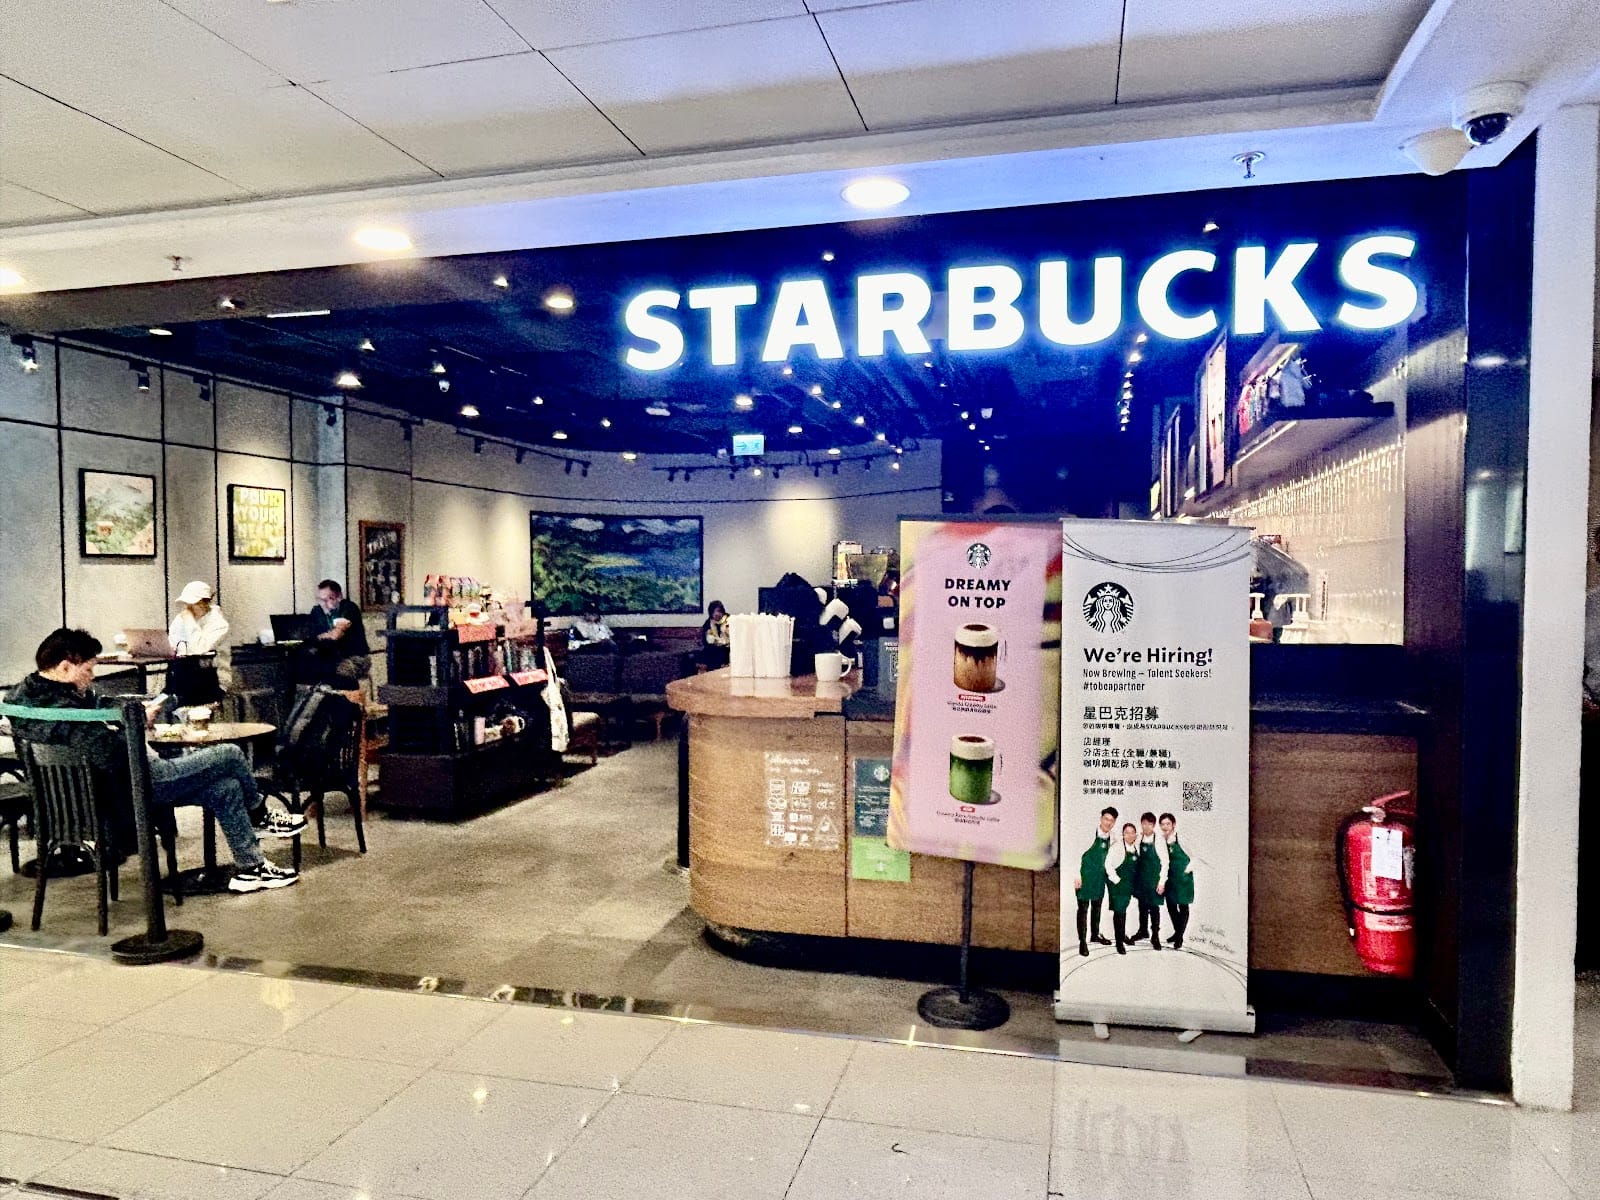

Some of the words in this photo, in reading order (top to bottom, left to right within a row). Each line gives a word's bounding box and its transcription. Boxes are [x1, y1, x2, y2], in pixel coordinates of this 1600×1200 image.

[625, 234, 1419, 372] STARBUCKS
[945, 578, 1011, 591] DREAMY
[948, 595, 969, 608] ON
[975, 597, 1006, 609] TOP
[1147, 647, 1213, 667] Hiring!
[1083, 669, 1100, 678] Now
[1102, 669, 1136, 679] Brewing
[1148, 669, 1173, 678] Talent
[1175, 669, 1212, 679] Seekers!
[1083, 682, 1145, 692] #tobeapartner
[1083, 706, 1160, 721] 星巴克招募
